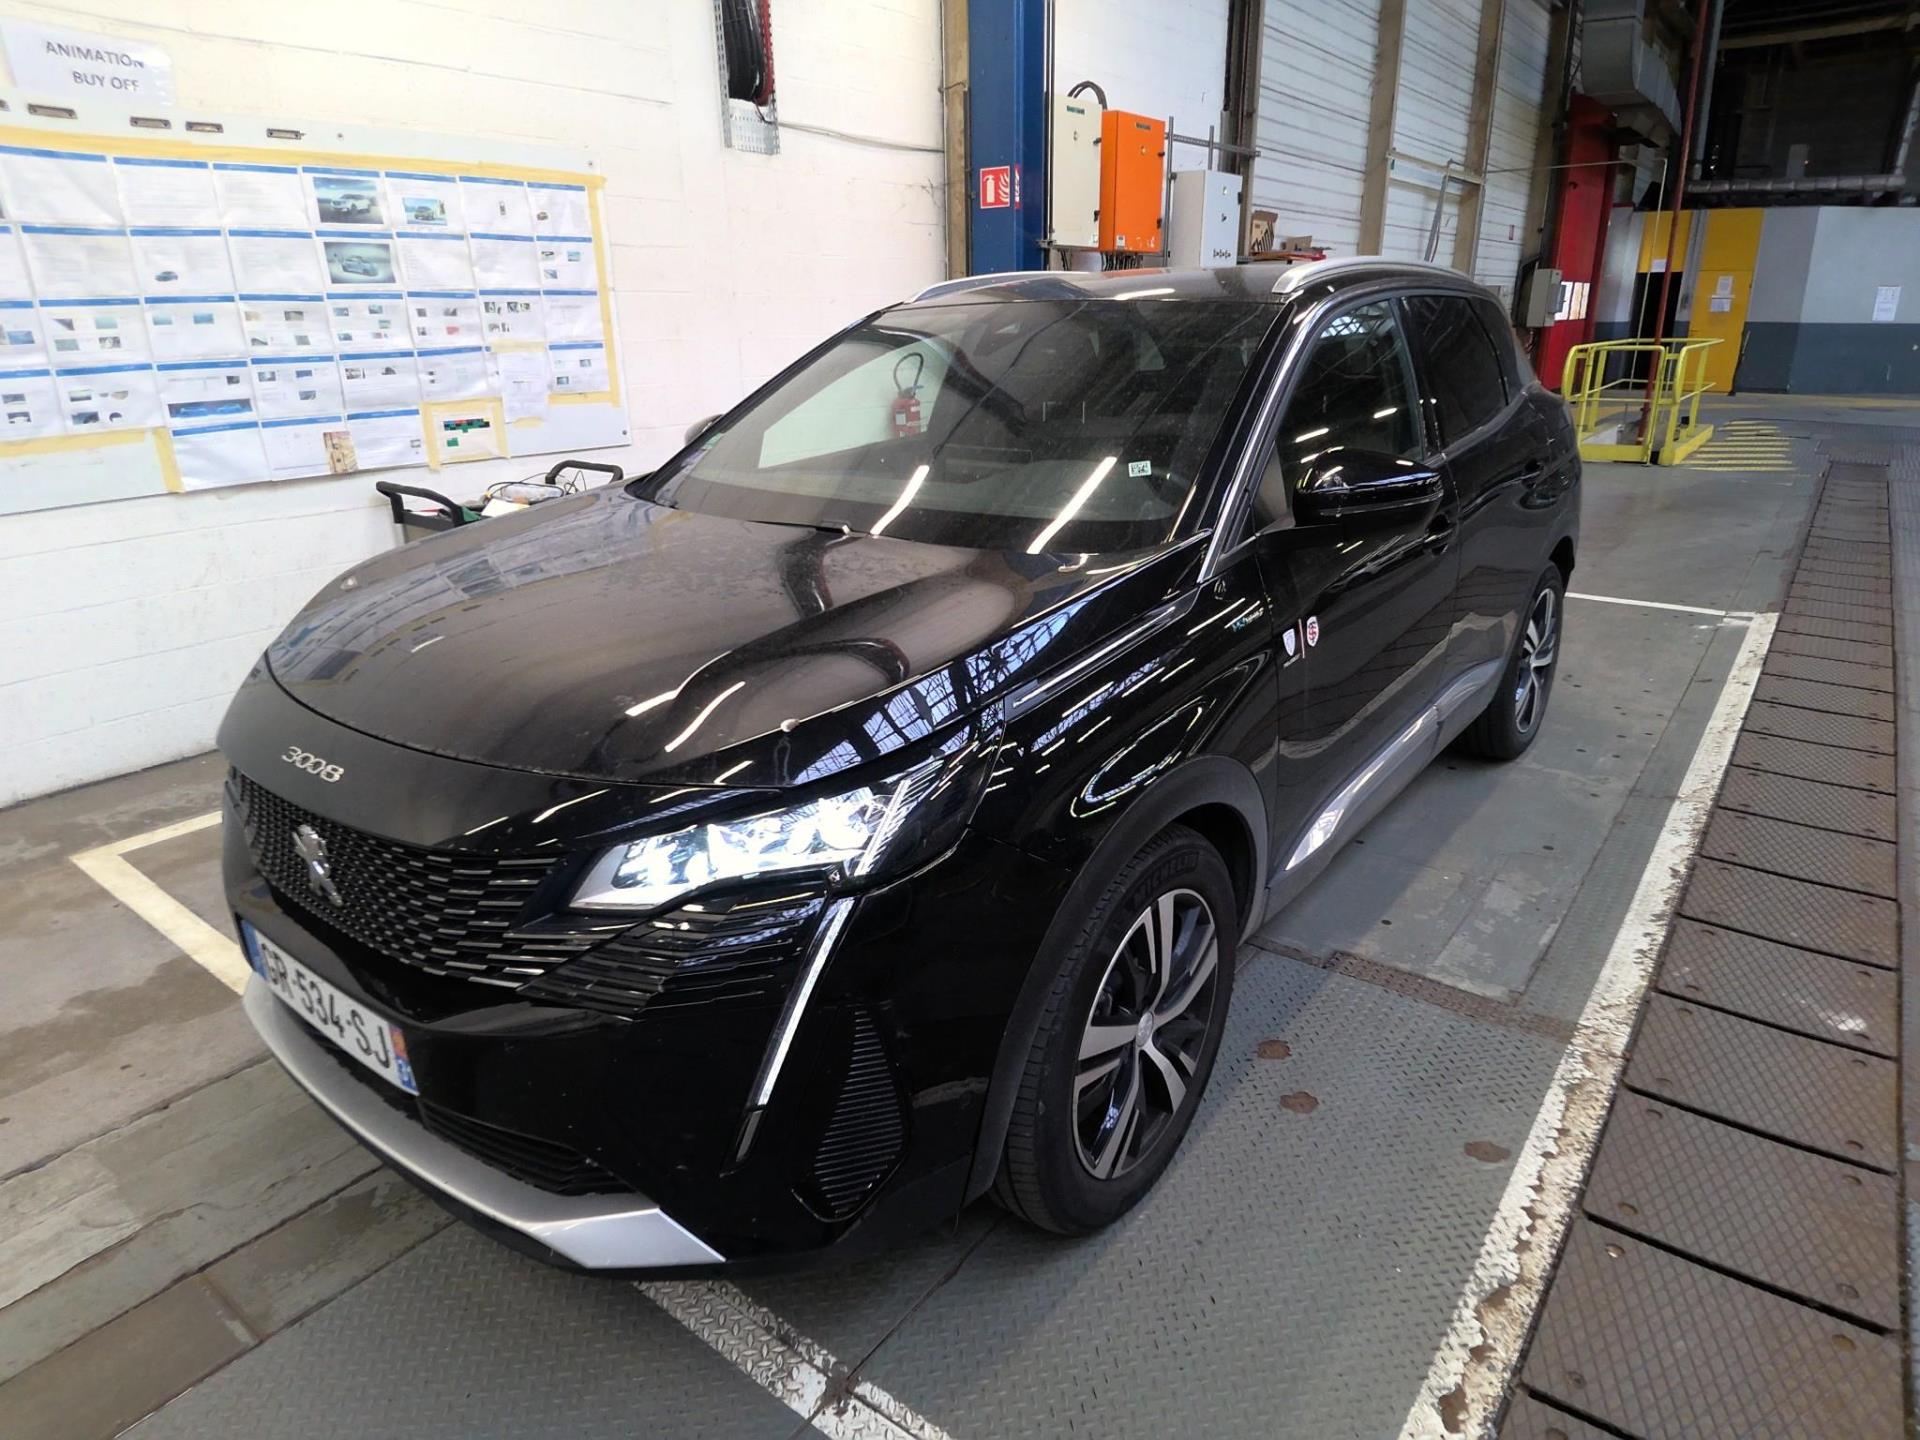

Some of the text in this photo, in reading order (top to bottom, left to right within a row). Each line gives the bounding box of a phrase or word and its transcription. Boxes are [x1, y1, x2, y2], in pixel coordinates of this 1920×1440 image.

[73, 70, 139, 91] BUY OFF
[281, 746, 345, 782] 3008
